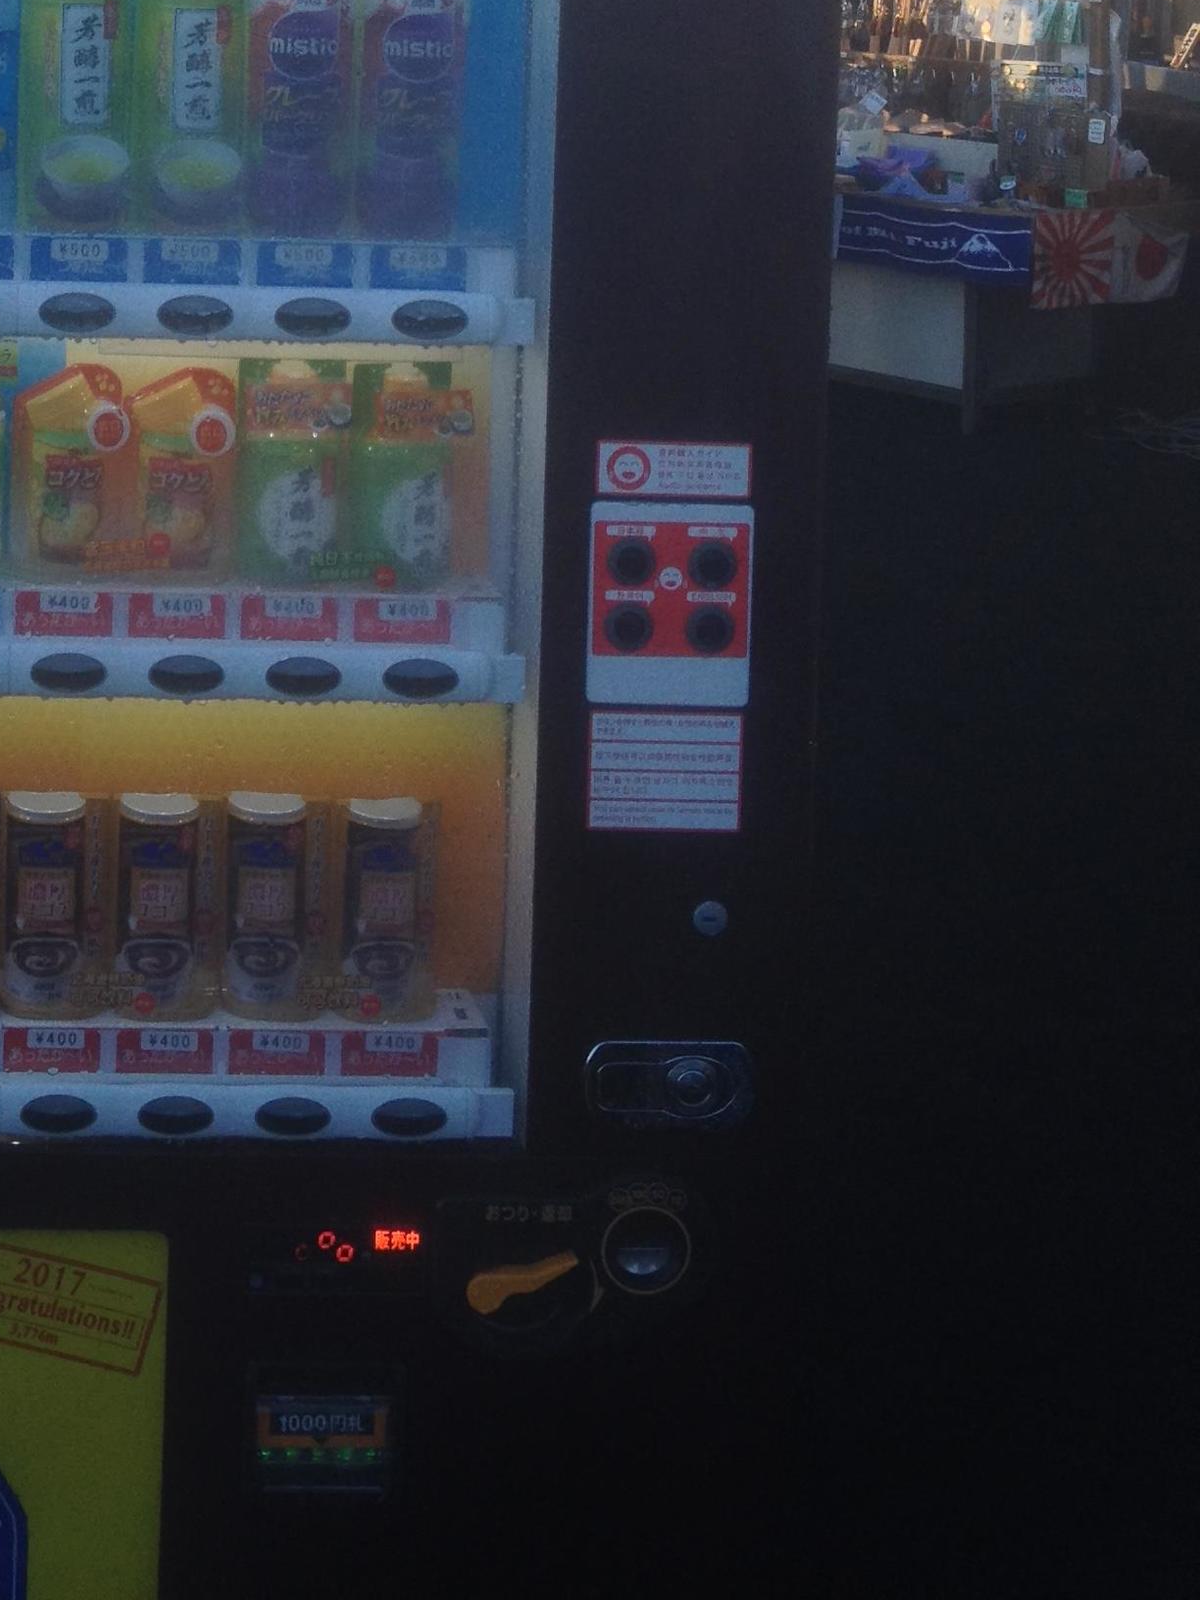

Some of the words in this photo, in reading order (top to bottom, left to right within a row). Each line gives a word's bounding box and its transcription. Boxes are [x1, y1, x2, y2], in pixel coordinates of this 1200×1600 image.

[905, 234, 958, 250] Fuji
[47, 596, 91, 610] ¥400
[161, 598, 204, 613] ¥400
[36, 1031, 77, 1046] ¥400
[149, 1032, 191, 1048] ¥400
[260, 1033, 302, 1050] ¥400
[374, 1034, 415, 1050] ¥400
[375, 1230, 420, 1251] 販売中
[13, 1257, 87, 1297] 2017
